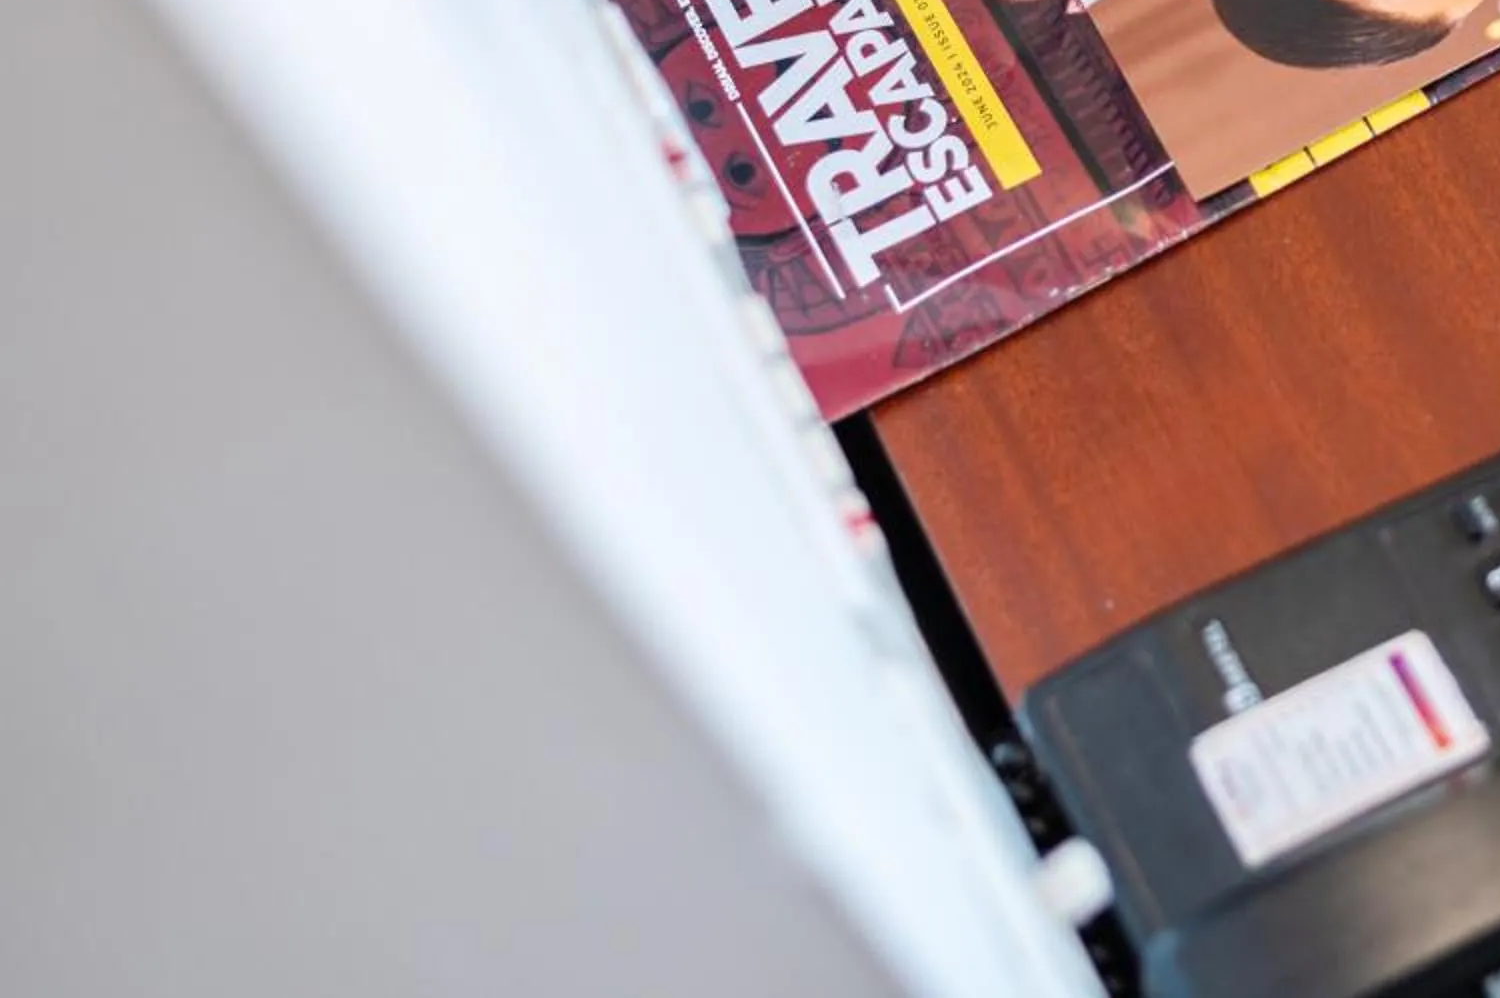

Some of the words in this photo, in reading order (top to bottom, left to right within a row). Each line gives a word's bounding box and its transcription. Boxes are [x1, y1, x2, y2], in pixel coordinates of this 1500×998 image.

[923, 12, 952, 52] ISSUE
[951, 60, 977, 94] 2024
[971, 95, 998, 131] JUNE
